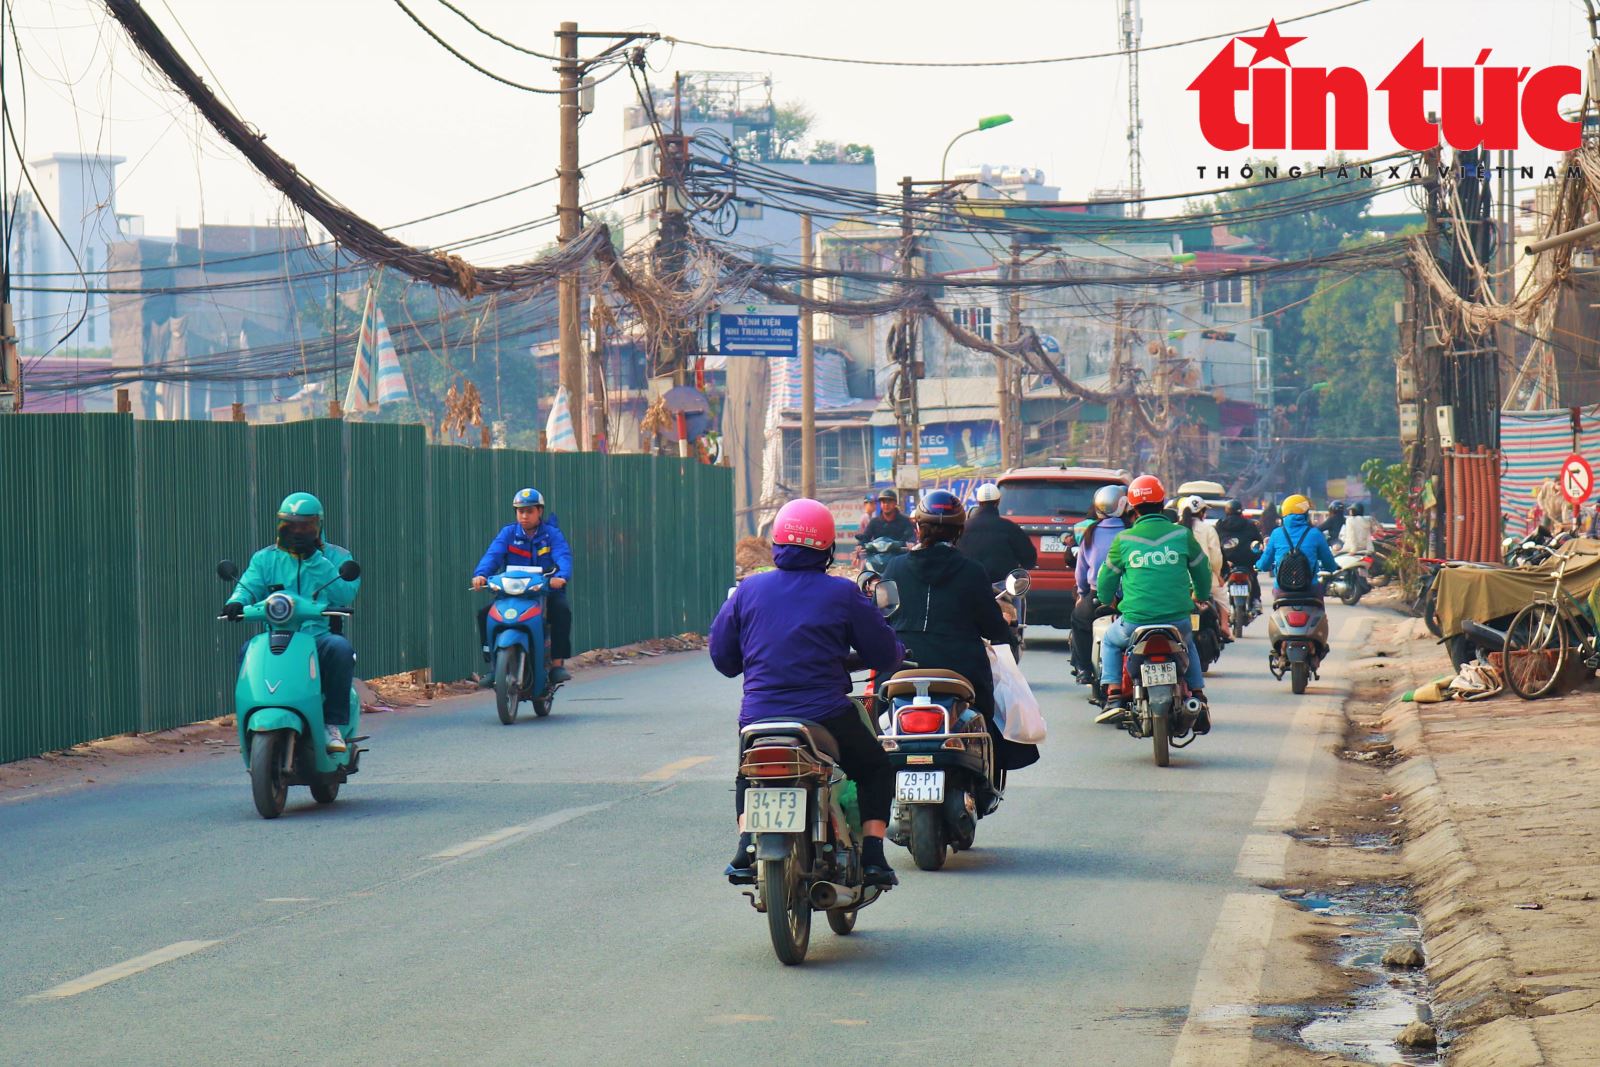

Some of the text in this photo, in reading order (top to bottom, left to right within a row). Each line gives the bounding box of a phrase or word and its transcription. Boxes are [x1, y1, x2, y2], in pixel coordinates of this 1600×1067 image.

[741, 328, 768, 336] TRUNG
[882, 435, 945, 447] MELTEC
[1128, 546, 1179, 568] Grab
[904, 773, 937, 786] 29-P1
[752, 792, 797, 809] 34-F3
[900, 787, 940, 801] 561.11
[751, 811, 796, 828] 0147
